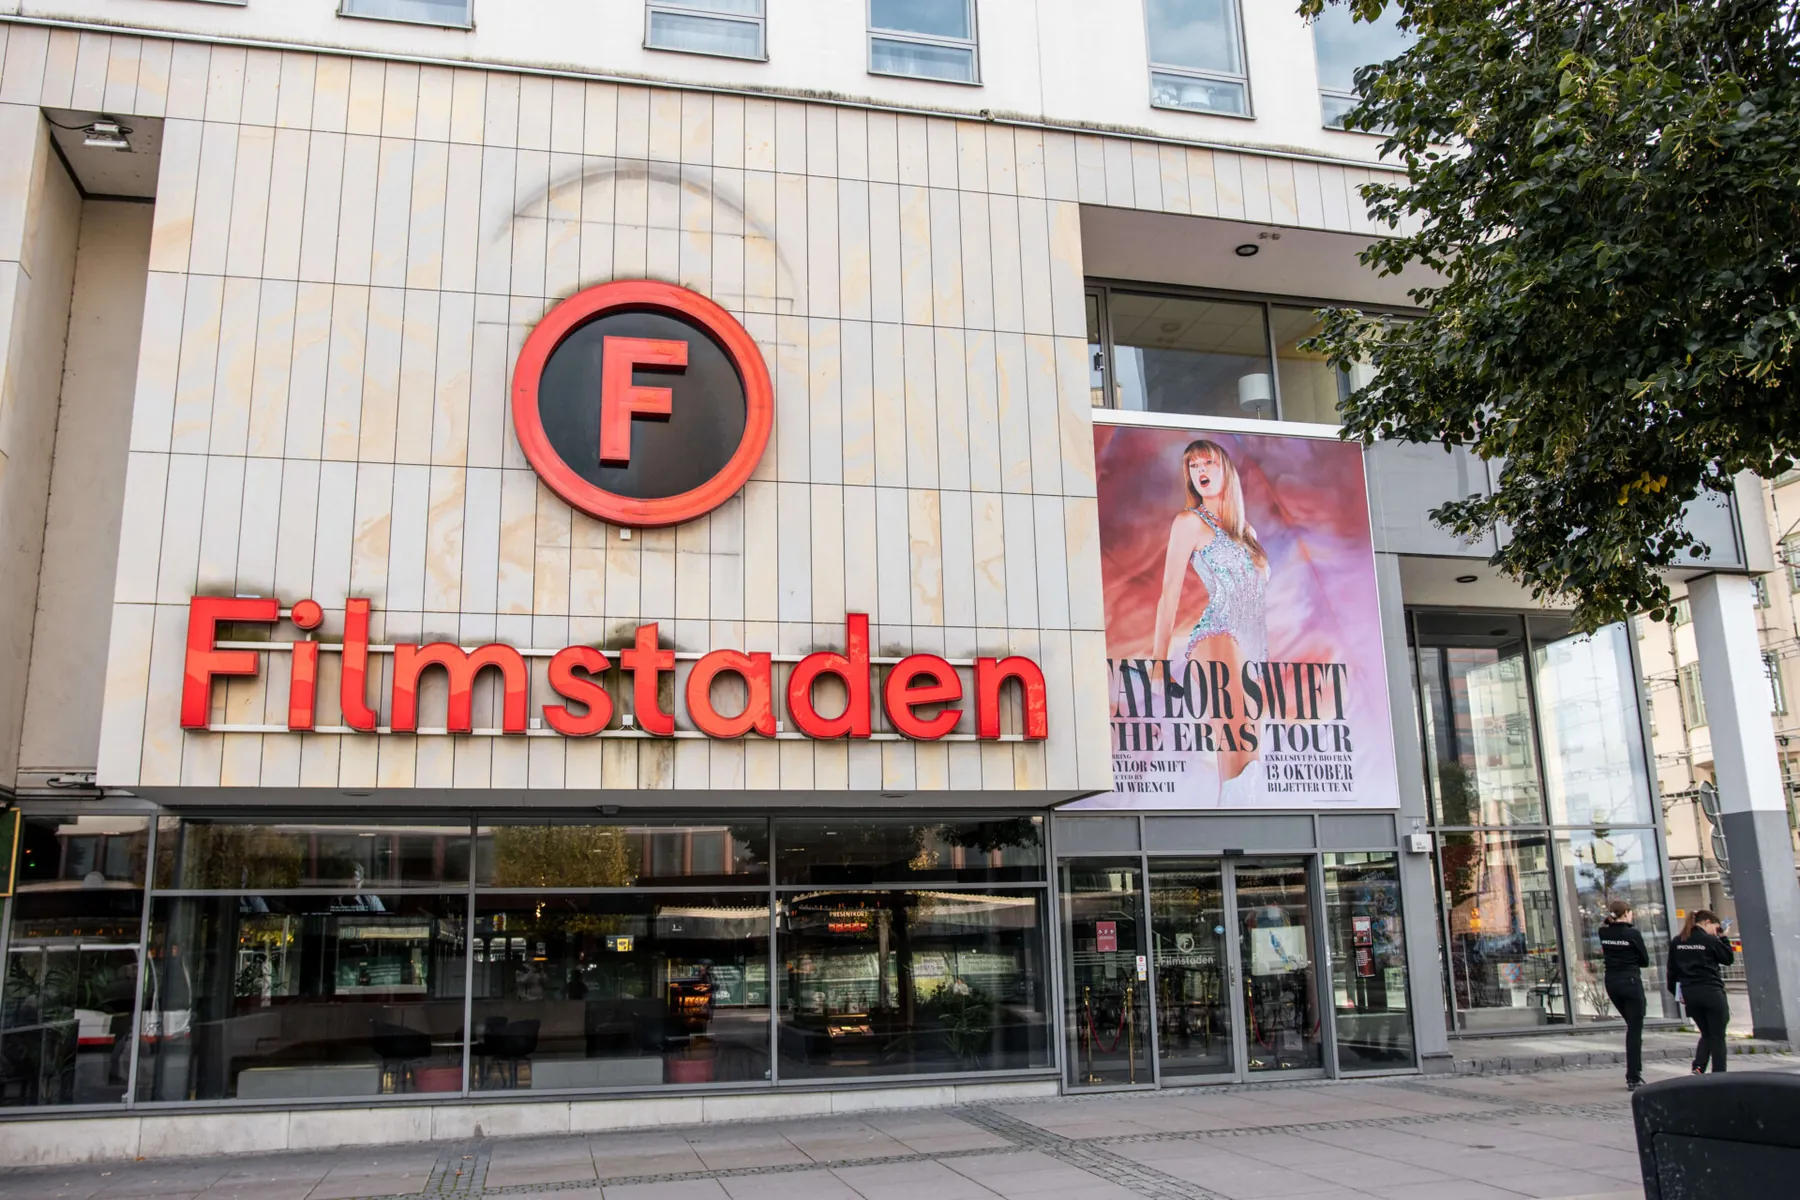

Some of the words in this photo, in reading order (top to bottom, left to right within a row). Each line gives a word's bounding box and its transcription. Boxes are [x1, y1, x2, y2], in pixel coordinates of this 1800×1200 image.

[600, 335, 688, 465] F
[180, 595, 1048, 741] Filmstaden
[1242, 660, 1349, 721] SWIFT
[1172, 722, 1259, 753] ERAS
[1265, 723, 1354, 753] TOUR
[1265, 754, 1307, 762] EXKLUSIVT
[1307, 753, 1318, 762] PÅ
[1319, 754, 1332, 762] BIO
[1333, 753, 1353, 762] FRÅN
[1150, 760, 1187, 773] SWIFT
[1266, 763, 1280, 781] 13
[1283, 763, 1354, 781] OKTOBER
[1127, 781, 1176, 793] WRENCH
[1267, 782, 1320, 793] BILJETTER
[1321, 782, 1340, 793] UTE
[1341, 782, 1354, 793] NU
[1160, 955, 1214, 966] Filmstaden
